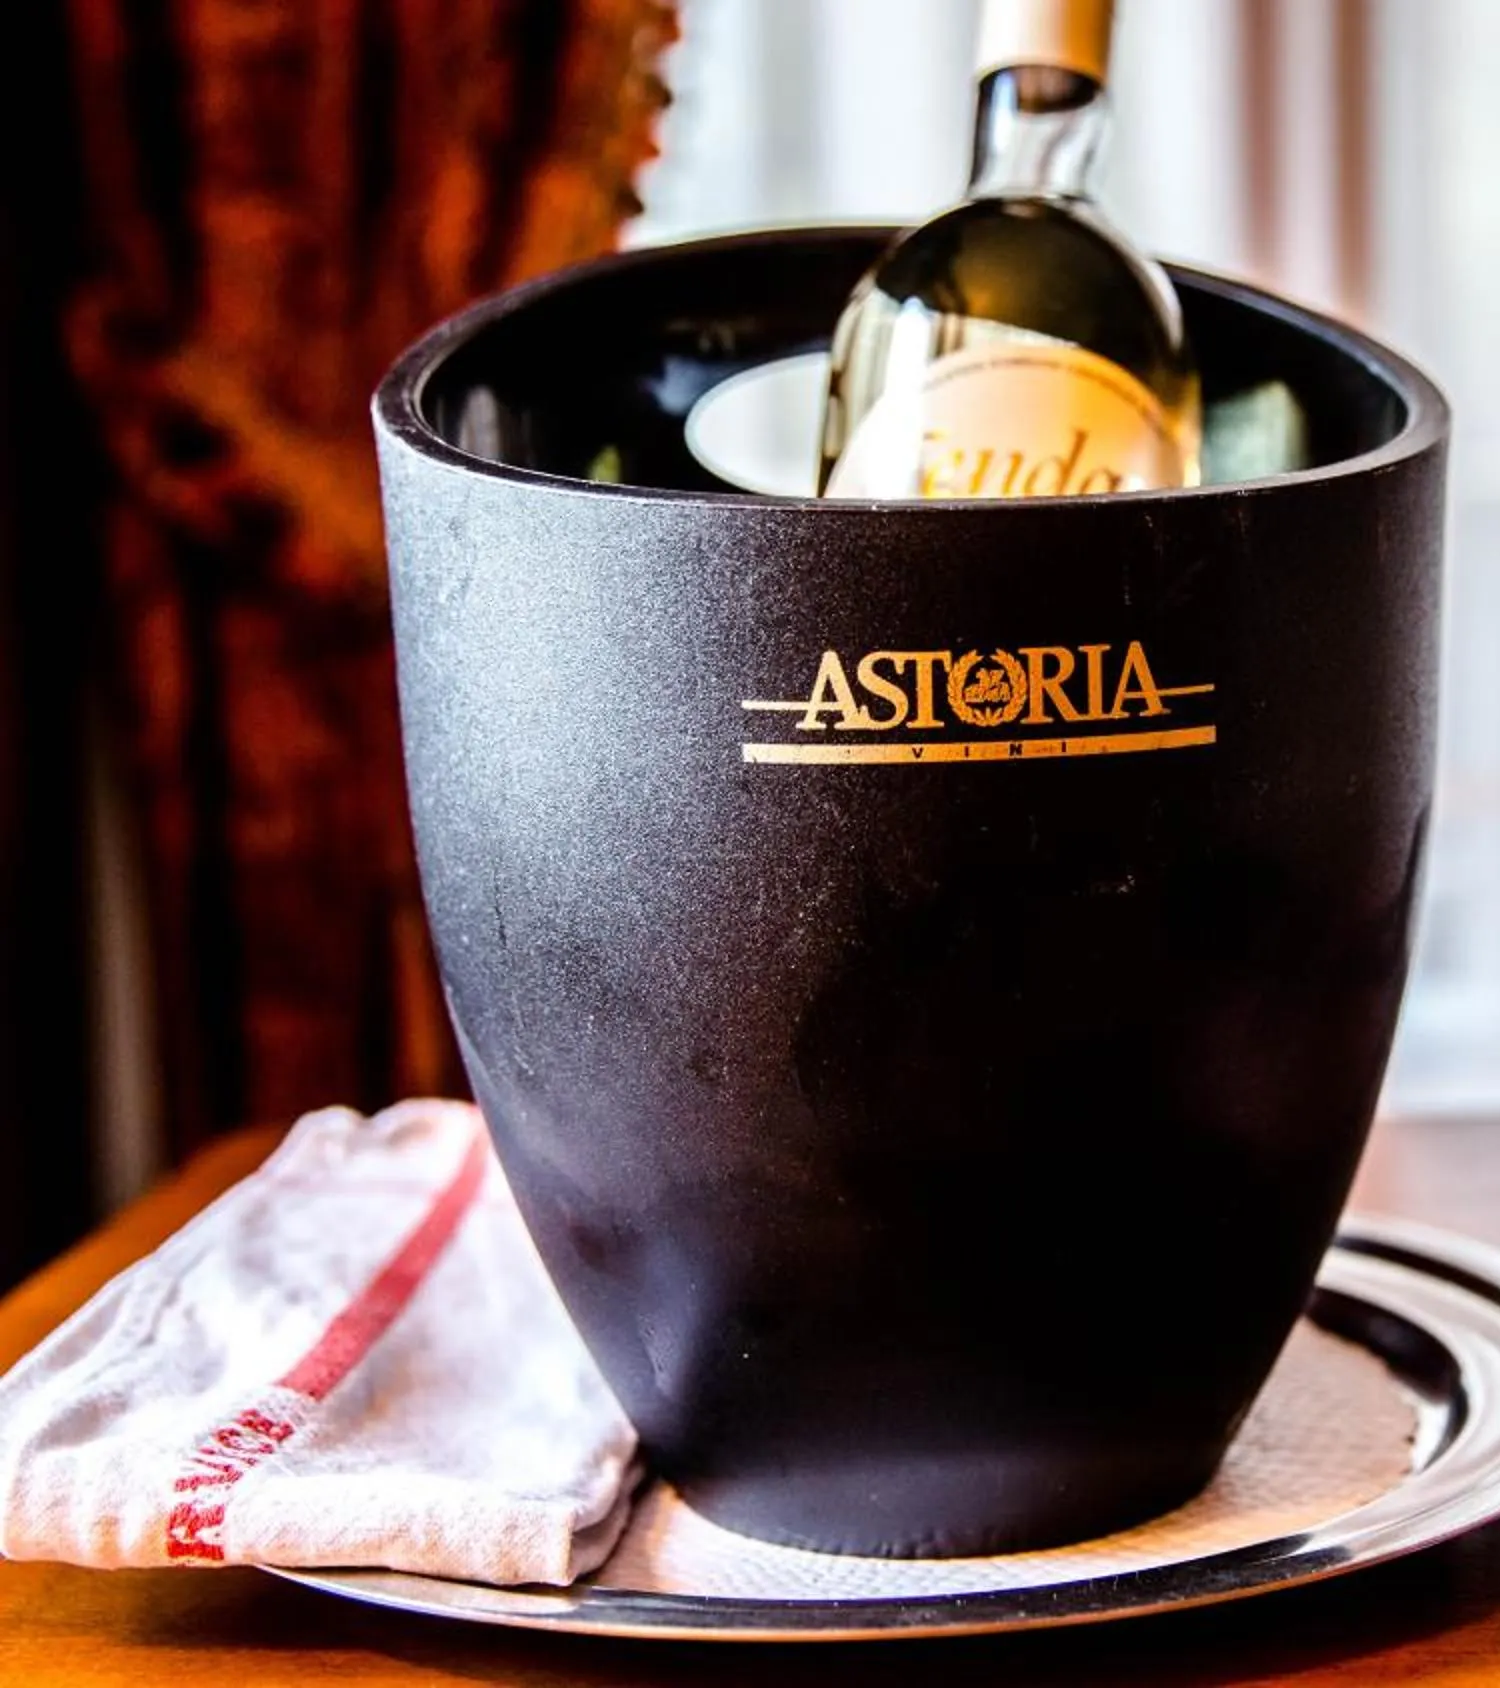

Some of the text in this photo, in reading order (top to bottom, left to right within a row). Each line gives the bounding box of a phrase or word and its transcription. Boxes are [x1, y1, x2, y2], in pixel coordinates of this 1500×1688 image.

[795, 640, 1172, 732] ASTORIA
[911, 740, 1067, 759] VINI
[166, 1409, 296, 1563] RVICE
